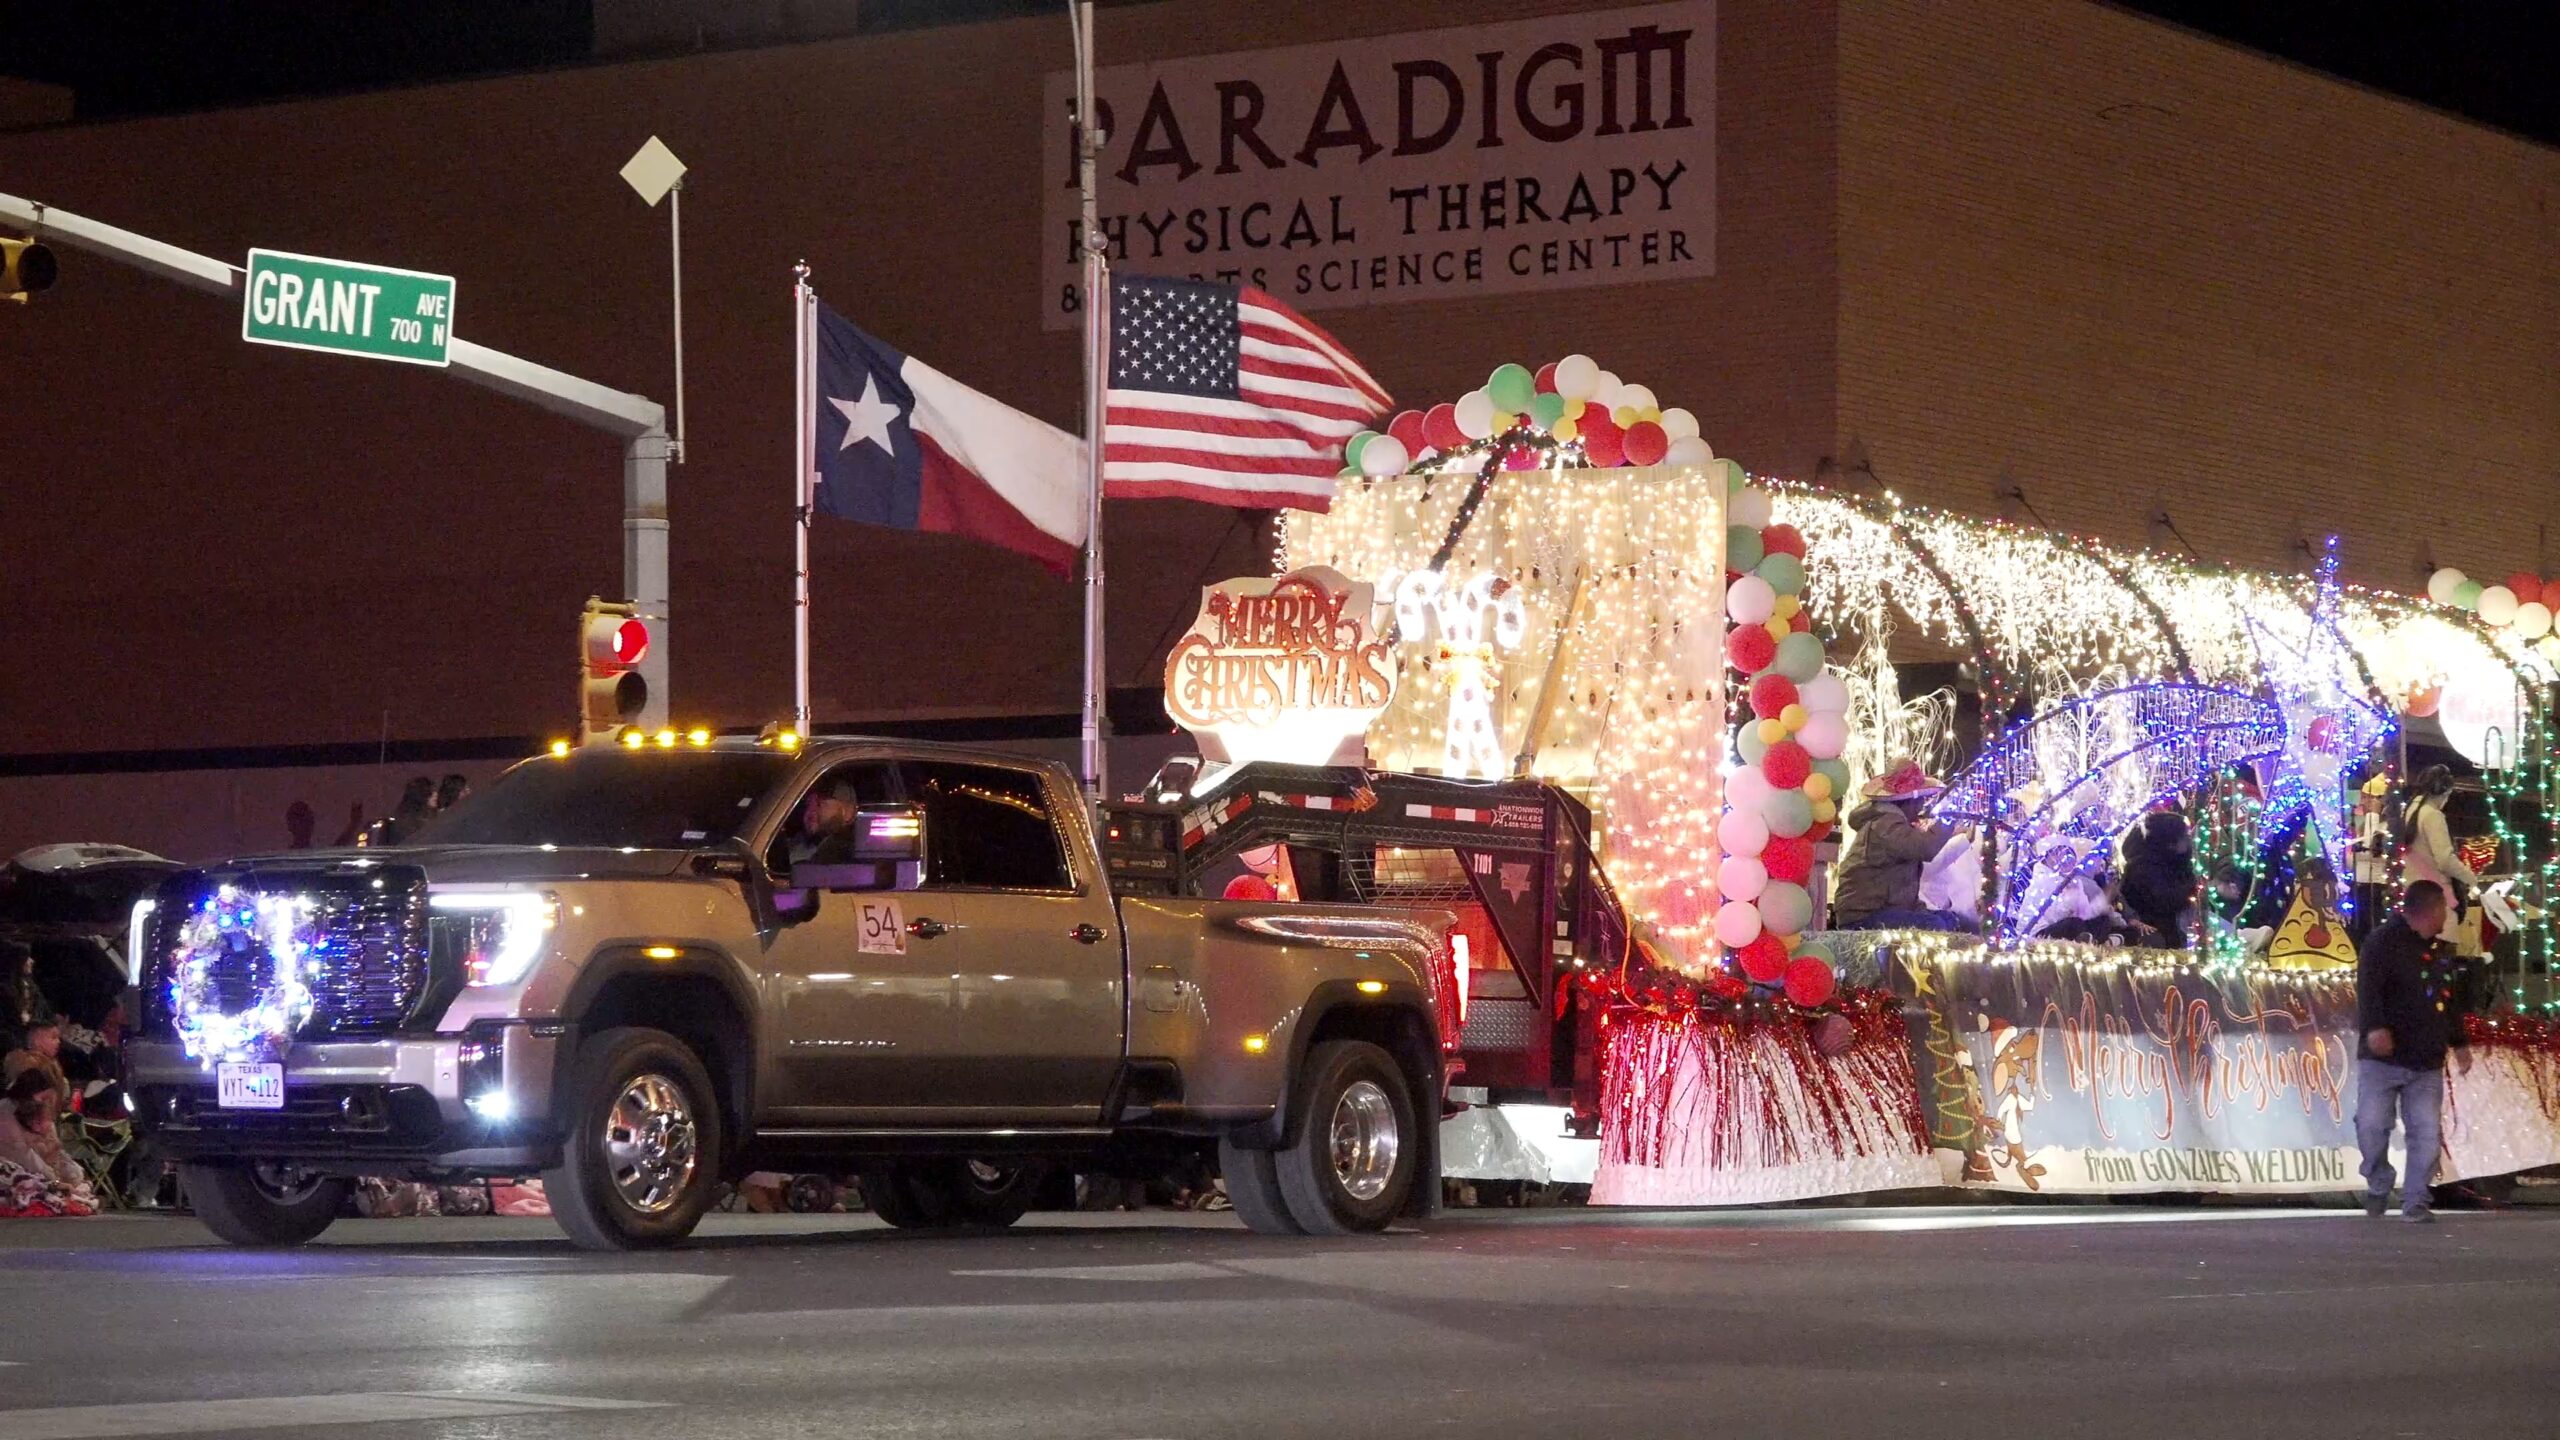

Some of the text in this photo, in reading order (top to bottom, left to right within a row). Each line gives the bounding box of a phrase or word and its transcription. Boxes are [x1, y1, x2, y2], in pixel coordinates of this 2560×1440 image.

[1065, 25, 1694, 189] PARADIGM
[1389, 159, 1687, 235] THERAPY
[1295, 246, 1483, 295] SCIENCE
[1508, 230, 1694, 277] CENTER
[253, 269, 446, 337] GRANT AVE
[390, 317, 445, 346] 700 N
[1208, 577, 1360, 653] MERRY
[1164, 633, 1391, 727] CHRISTMAS
[1508, 813, 1543, 823] TRAILERS
[862, 904, 898, 938] 54
[238, 1066, 262, 1074] TEXAS
[2036, 974, 2350, 1142] Merry Christmas
[2084, 1147, 2344, 1184] from GONZALES WELDING
